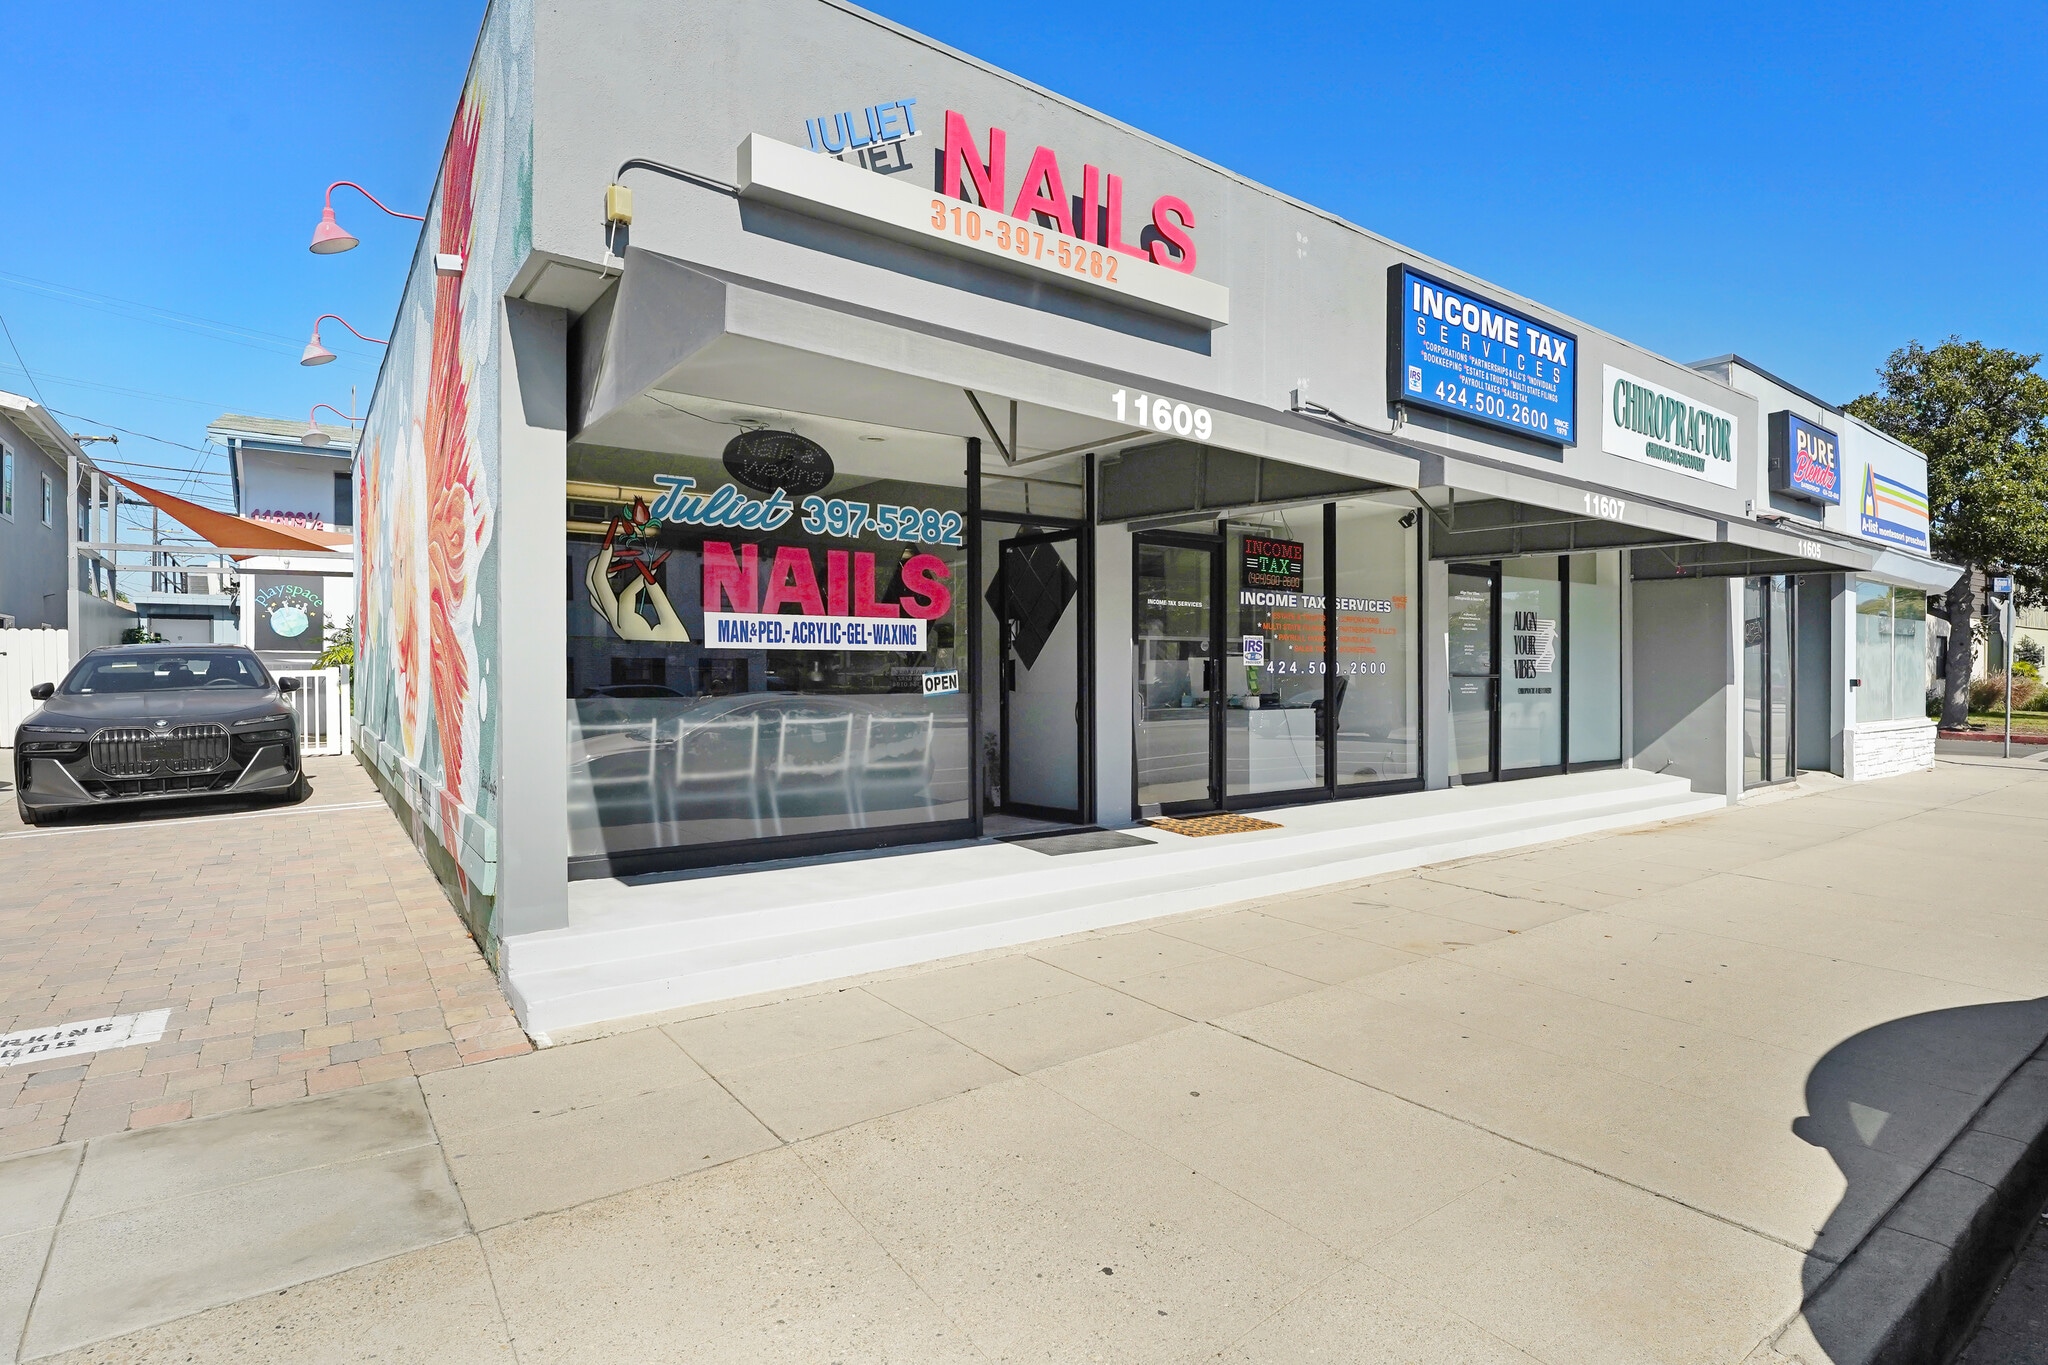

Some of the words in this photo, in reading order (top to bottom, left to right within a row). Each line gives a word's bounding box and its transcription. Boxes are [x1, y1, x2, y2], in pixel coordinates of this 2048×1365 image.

[803, 97, 917, 154] JULIET
[943, 109, 1197, 275] NAILS
[930, 200, 1119, 284] 310-397-5282
[1413, 281, 1519, 349] INCOME
[1526, 327, 1567, 367] TAX
[1417, 316, 1560, 384] SERVICES
[1425, 341, 1468, 362] CORPORATIONS
[1471, 356, 1508, 376] PARTNERSHIPS
[1410, 369, 1420, 381] IRS
[1423, 351, 1462, 372] BOOKKEEPING
[1466, 366, 1485, 379] ESTATE
[1490, 373, 1508, 386] TRUSTS
[1527, 385, 1540, 397] STATE
[1461, 375, 1484, 390] PAYROLL
[1485, 382, 1500, 394] TAXES
[1504, 388, 1518, 400] SALES
[1519, 394, 1528, 403] TAX
[1112, 389, 1212, 440] 11609
[1435, 380, 1548, 430] 424.500.2600
[1553, 418, 1569, 429] SINCE
[1613, 378, 1732, 462] CHIROPRACTOR
[1797, 429, 1834, 469] PURE
[743, 459, 825, 486] Waxing
[1793, 449, 1837, 490] Blendz
[651, 474, 794, 532] Juliet
[1583, 493, 1626, 520] 11607
[1862, 517, 1879, 534] A-list
[1245, 540, 1303, 559] INCOME
[1798, 540, 1821, 559] 11605
[1259, 556, 1289, 574] TAX
[702, 540, 952, 621] NAILS
[1240, 592, 1297, 607] INCOME
[1301, 596, 1326, 609] TAX
[1513, 611, 1538, 631] ALIGN
[1244, 640, 1263, 652] IRS
[1513, 635, 1536, 655] YOUR
[925, 674, 958, 692] OPEN
[1513, 659, 1537, 679] VIBES
